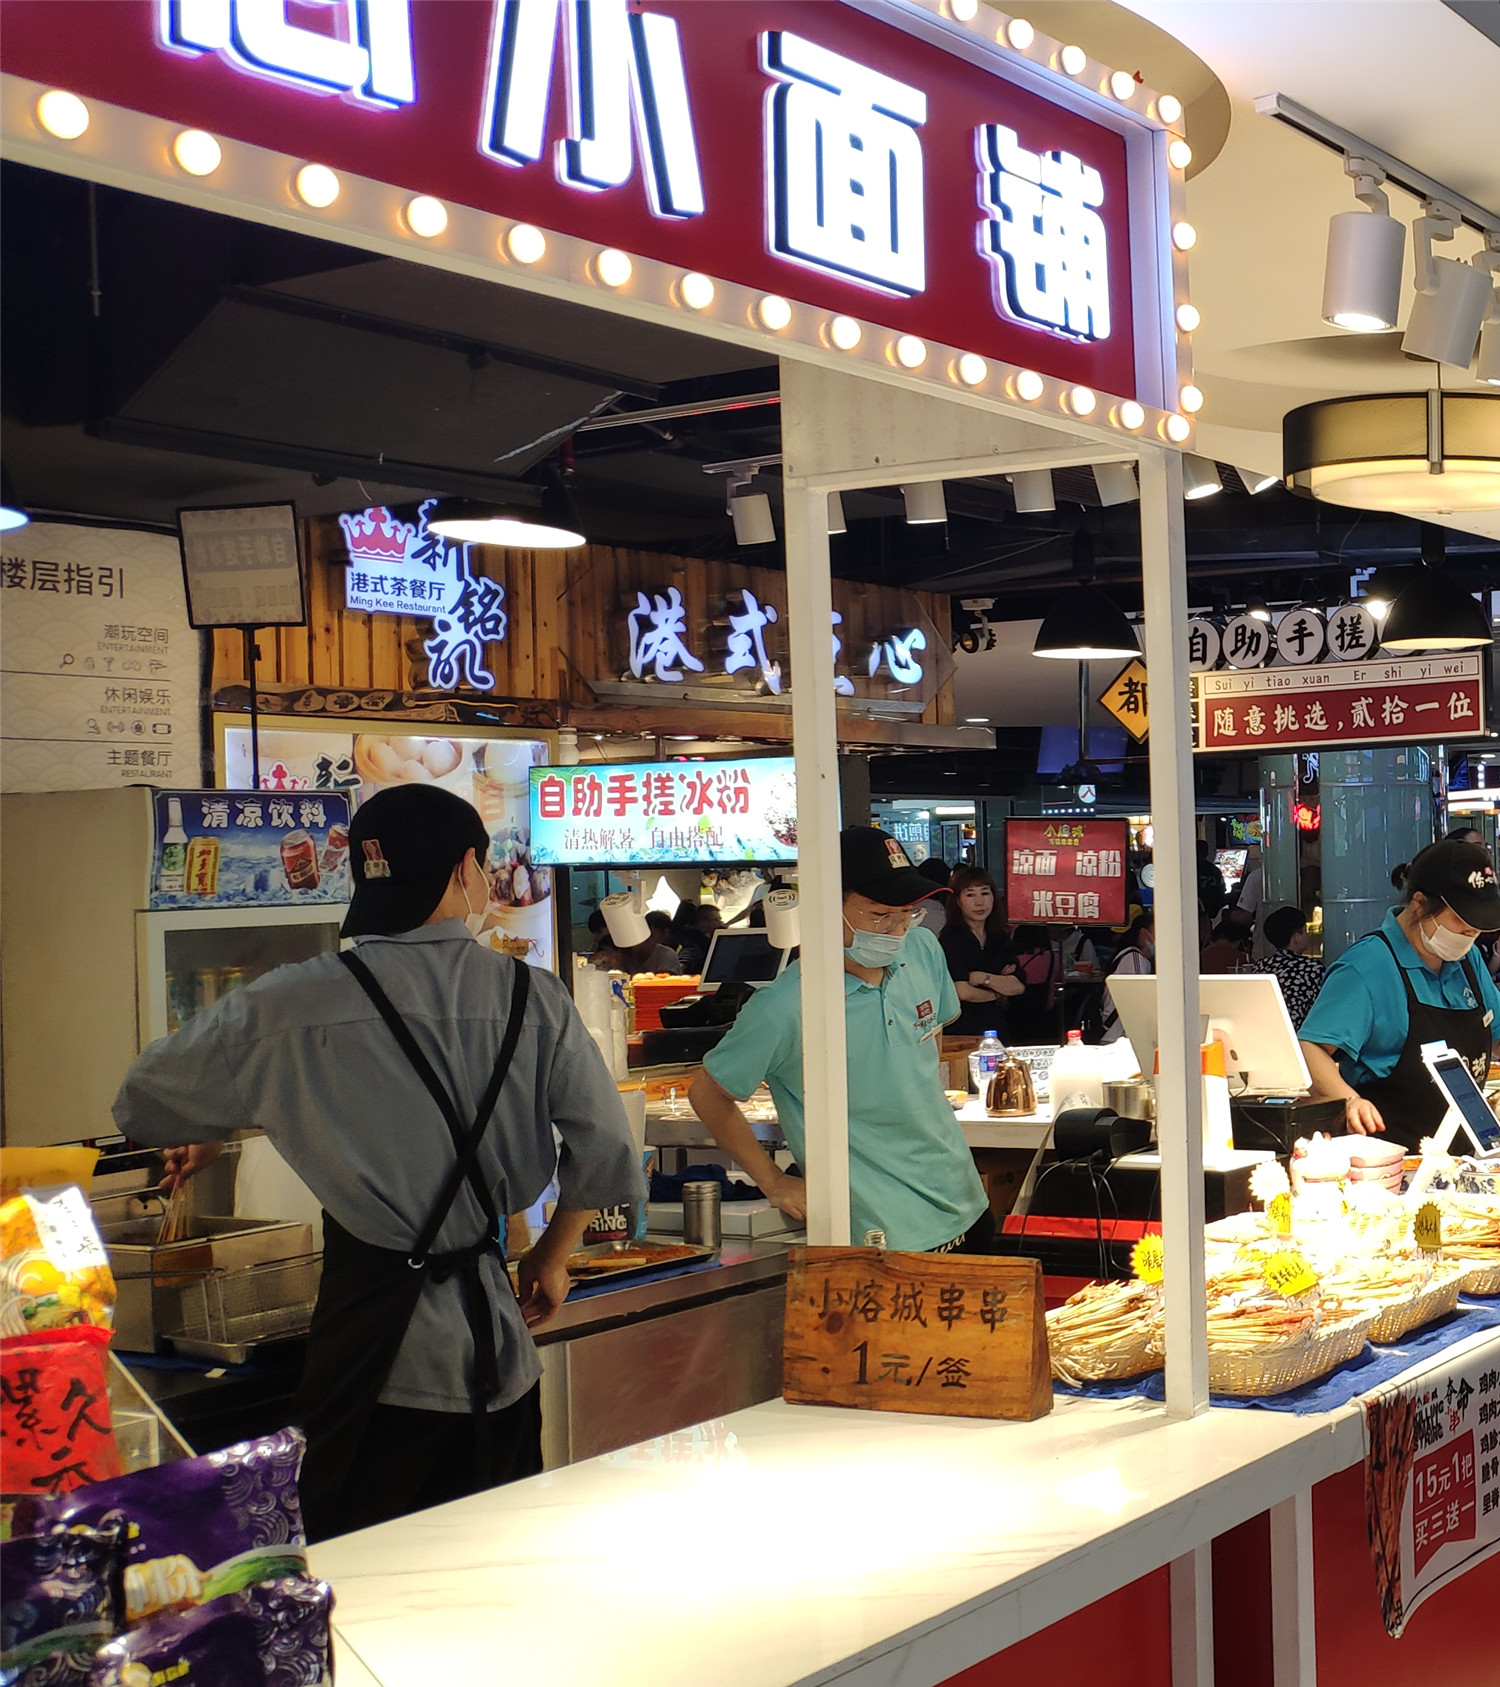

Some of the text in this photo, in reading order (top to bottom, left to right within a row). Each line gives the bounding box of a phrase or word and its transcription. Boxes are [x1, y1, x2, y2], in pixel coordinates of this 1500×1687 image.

[0, 556, 124, 599] 楼层指引
[350, 572, 446, 601] 港式茶餐厅
[350, 596, 446, 614] Ming Kee Restaurant
[97, 642, 169, 655] ENTERTAINMENT
[104, 624, 169, 644] 潮玩空间
[629, 586, 926, 695] 港式心
[1214, 661, 1465, 692] Sui yi tiao xuan Er shi yi wei
[100, 705, 171, 716] ENTERTAINMENT
[104, 687, 171, 705] 休闲娱乐
[107, 749, 172, 767] 主题餐厅
[121, 769, 173, 779] RESTAURANT
[539, 767, 751, 818] 自助手搓冰粉
[201, 798, 327, 829] 清凉饮料
[651, 826, 724, 849] 自由搭配
[1012, 849, 1121, 877] 凉面 凉粉
[1033, 890, 1100, 919] 米豆腐
[851, 1342, 972, 1390] 1元/签
[1415, 1451, 1473, 1504] 15元1把
[1415, 1499, 1475, 1552] 买三送一
